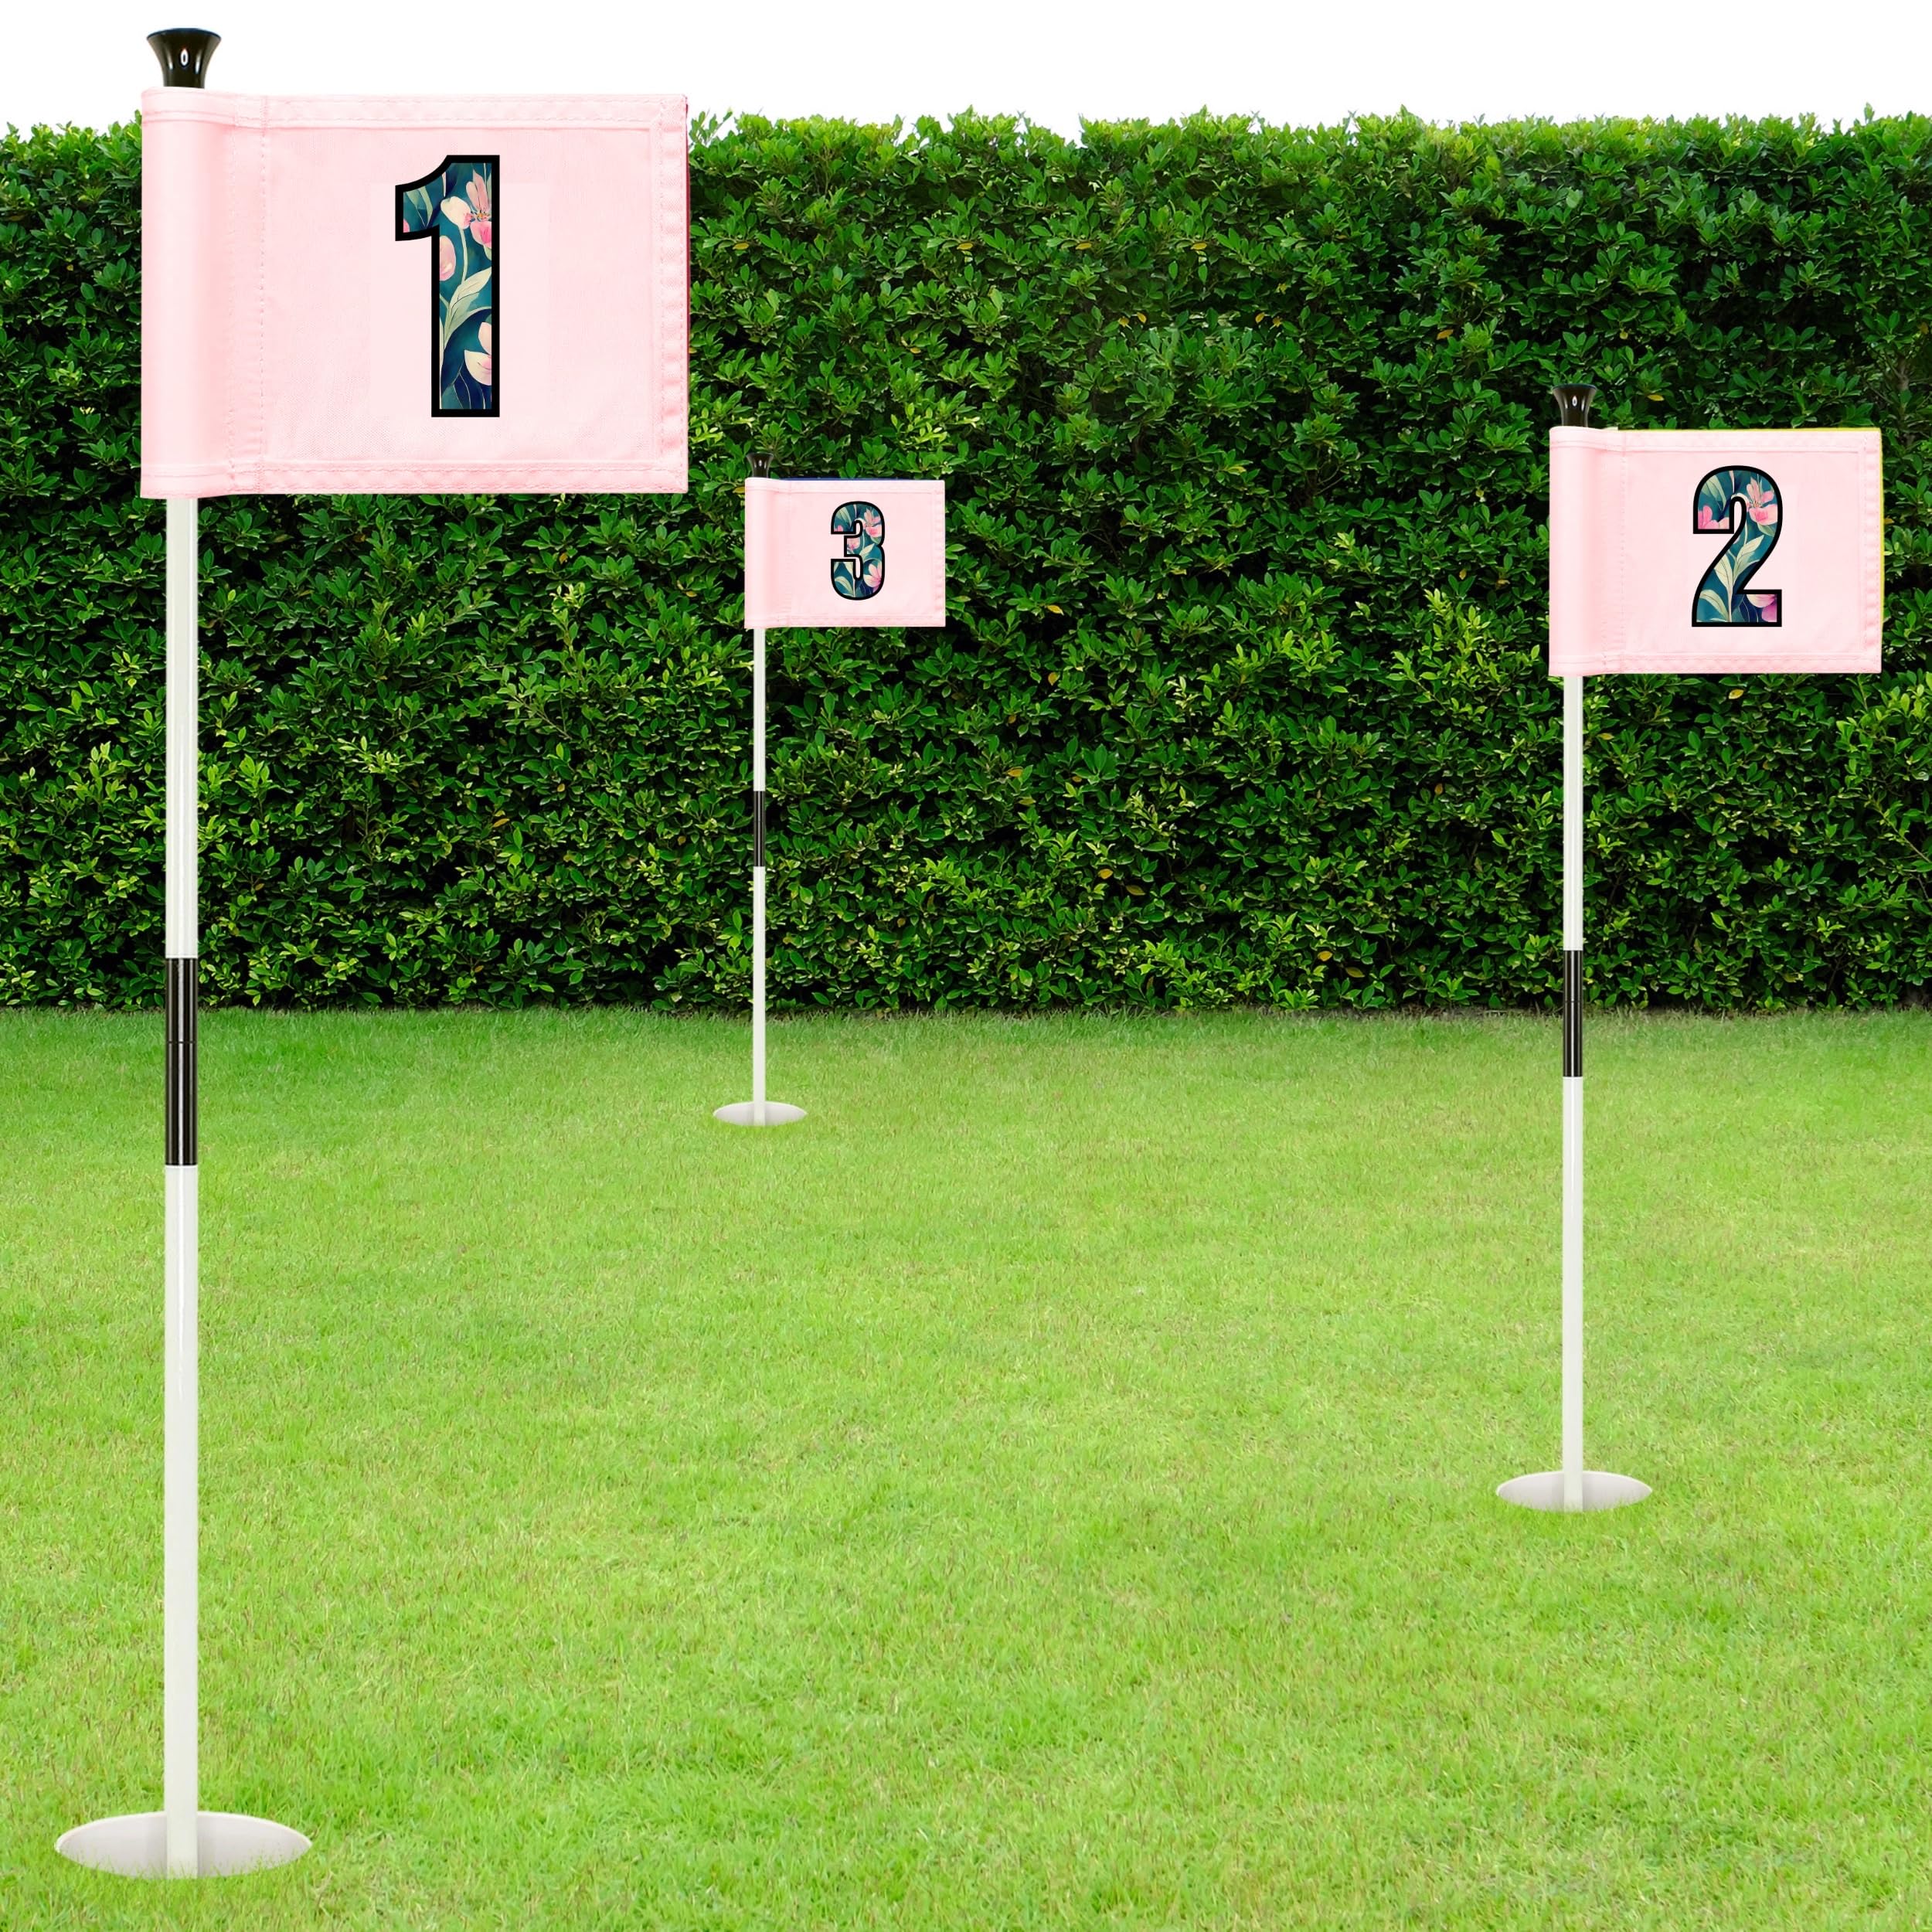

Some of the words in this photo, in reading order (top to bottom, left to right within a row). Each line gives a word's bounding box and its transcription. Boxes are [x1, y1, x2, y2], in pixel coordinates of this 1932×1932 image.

[395, 155, 500, 417] 1
[830, 501, 886, 601] 3
[1691, 465, 1783, 627] 2
